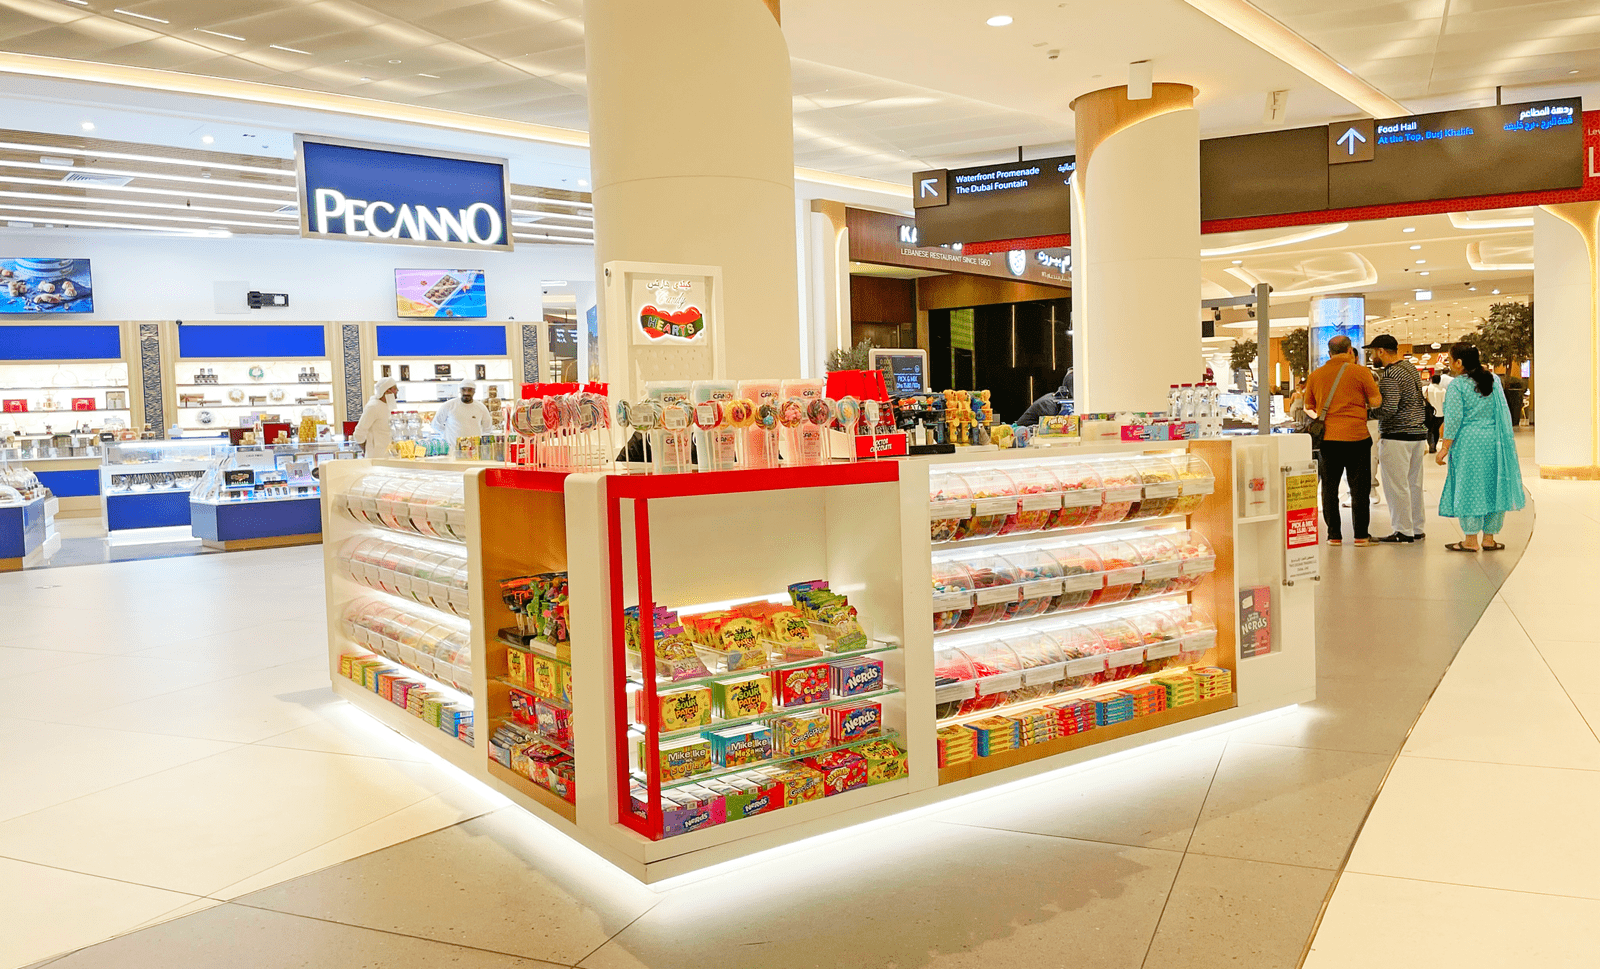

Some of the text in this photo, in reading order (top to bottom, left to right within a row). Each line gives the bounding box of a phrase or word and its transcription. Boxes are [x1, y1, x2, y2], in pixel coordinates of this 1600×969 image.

[1377, 121, 1417, 134] Food Hall
[1377, 126, 1474, 146] At the Top, Burj Khalifa
[955, 166, 1041, 185] Waterfront Promenade
[955, 179, 1029, 195] The Dubai Fountain
[314, 188, 503, 246] PECANNO
[900, 248, 992, 267] LEBANESE RESTAURANT SINCE 1960
[655, 290, 687, 308] Candy
[647, 316, 695, 336] HEARTS
[737, 687, 760, 700] SOUR
[675, 698, 697, 711] SOUR
[737, 695, 761, 709] PATCH
[675, 705, 698, 718] PATCH
[731, 738, 768, 752] Mike Ike
[668, 747, 706, 763] Mike Ike
